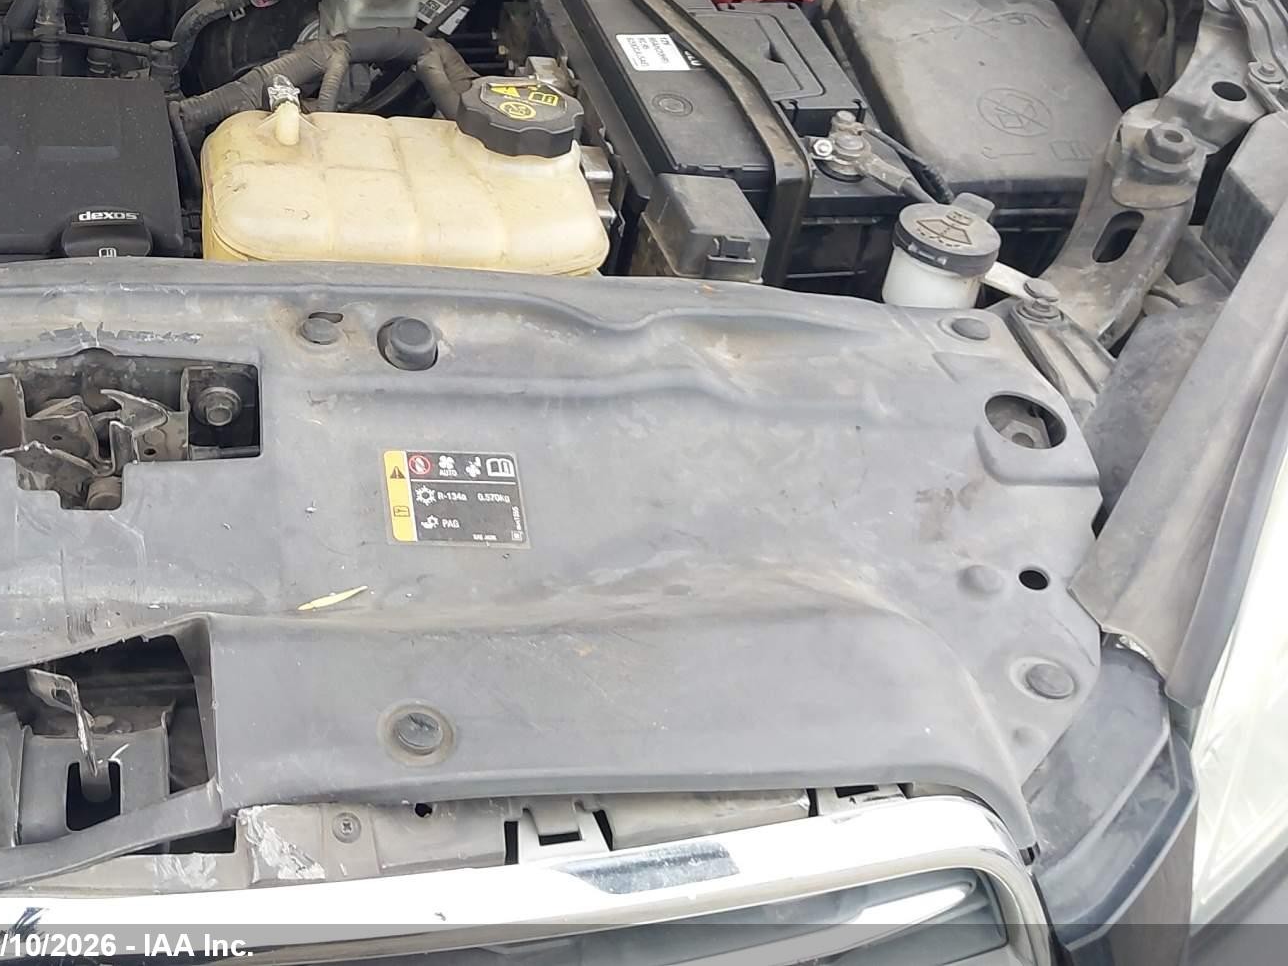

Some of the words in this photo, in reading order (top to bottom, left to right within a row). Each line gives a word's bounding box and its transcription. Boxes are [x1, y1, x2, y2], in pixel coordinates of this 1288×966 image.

[78, 210, 140, 221] dexos
[437, 491, 468, 501] R-134a
[441, 518, 460, 529] PAG
